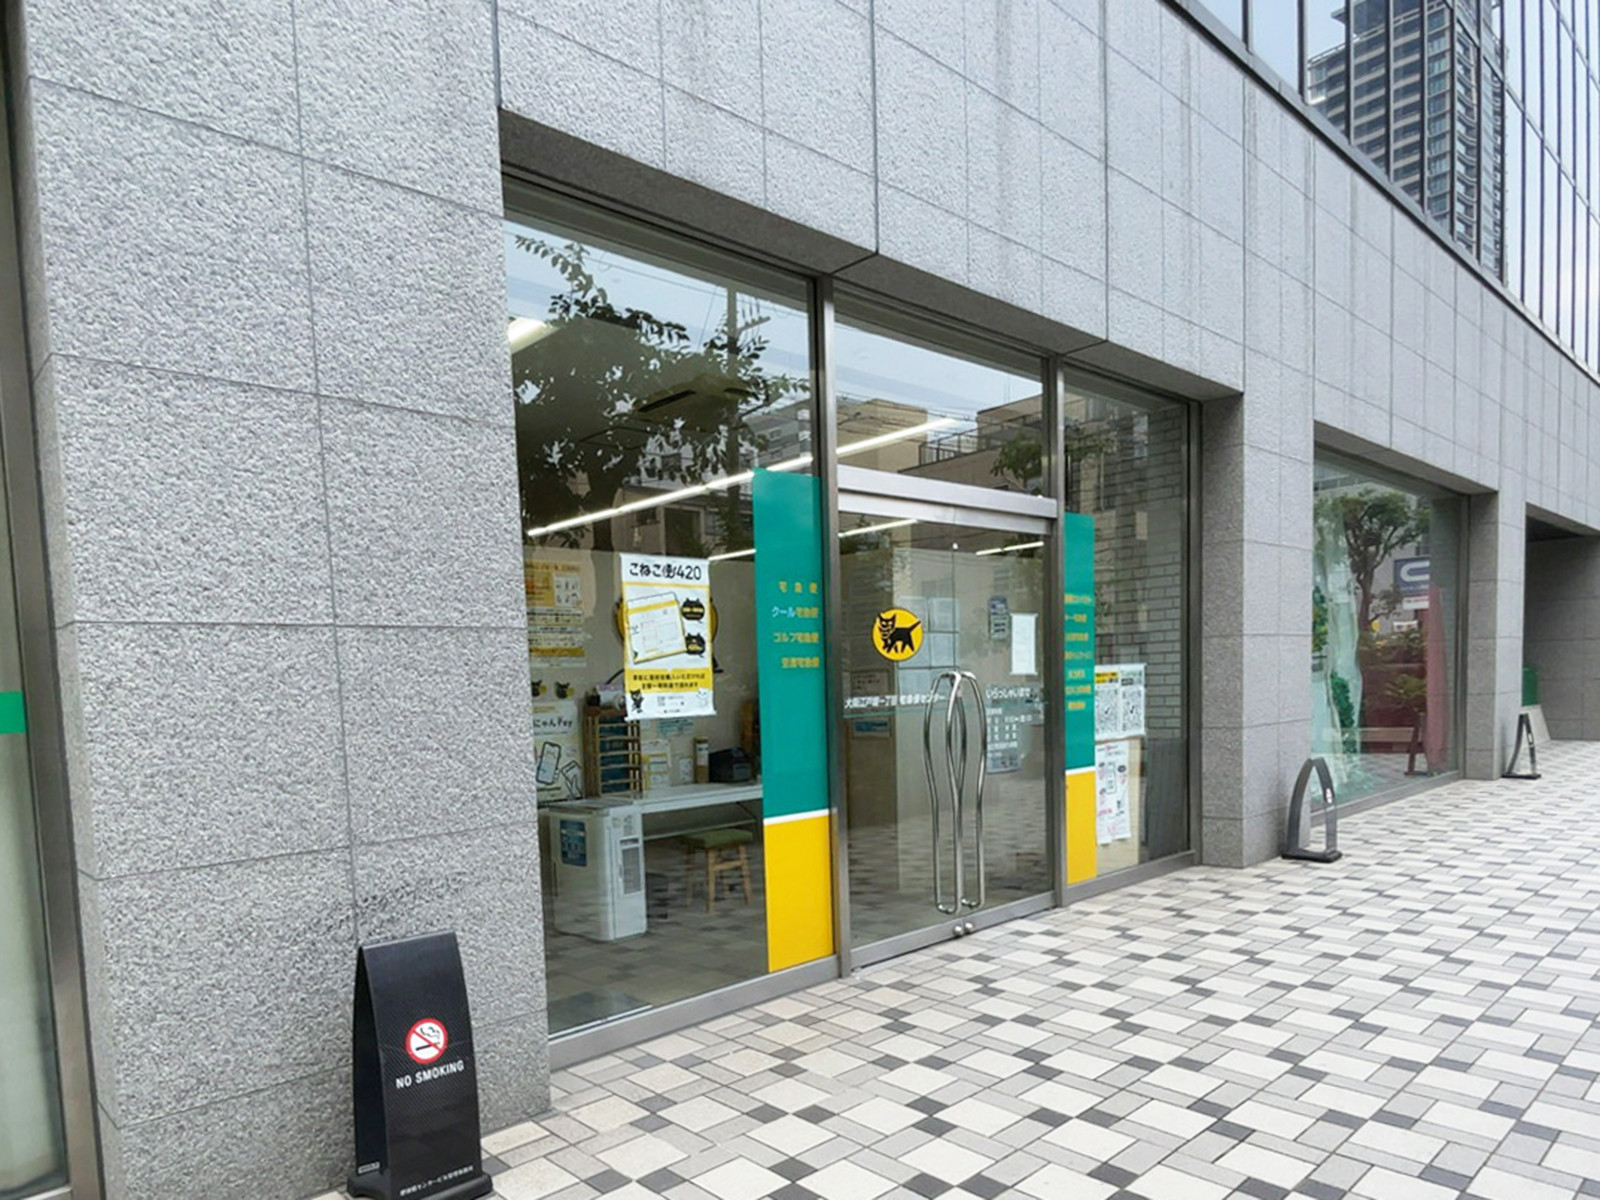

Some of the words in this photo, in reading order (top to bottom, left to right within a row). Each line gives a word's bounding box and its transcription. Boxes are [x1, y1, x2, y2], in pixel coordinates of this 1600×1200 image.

[629, 562, 702, 580] こねこ便420
[396, 1073, 412, 1090] NO
[415, 1059, 465, 1085] SMOKING
